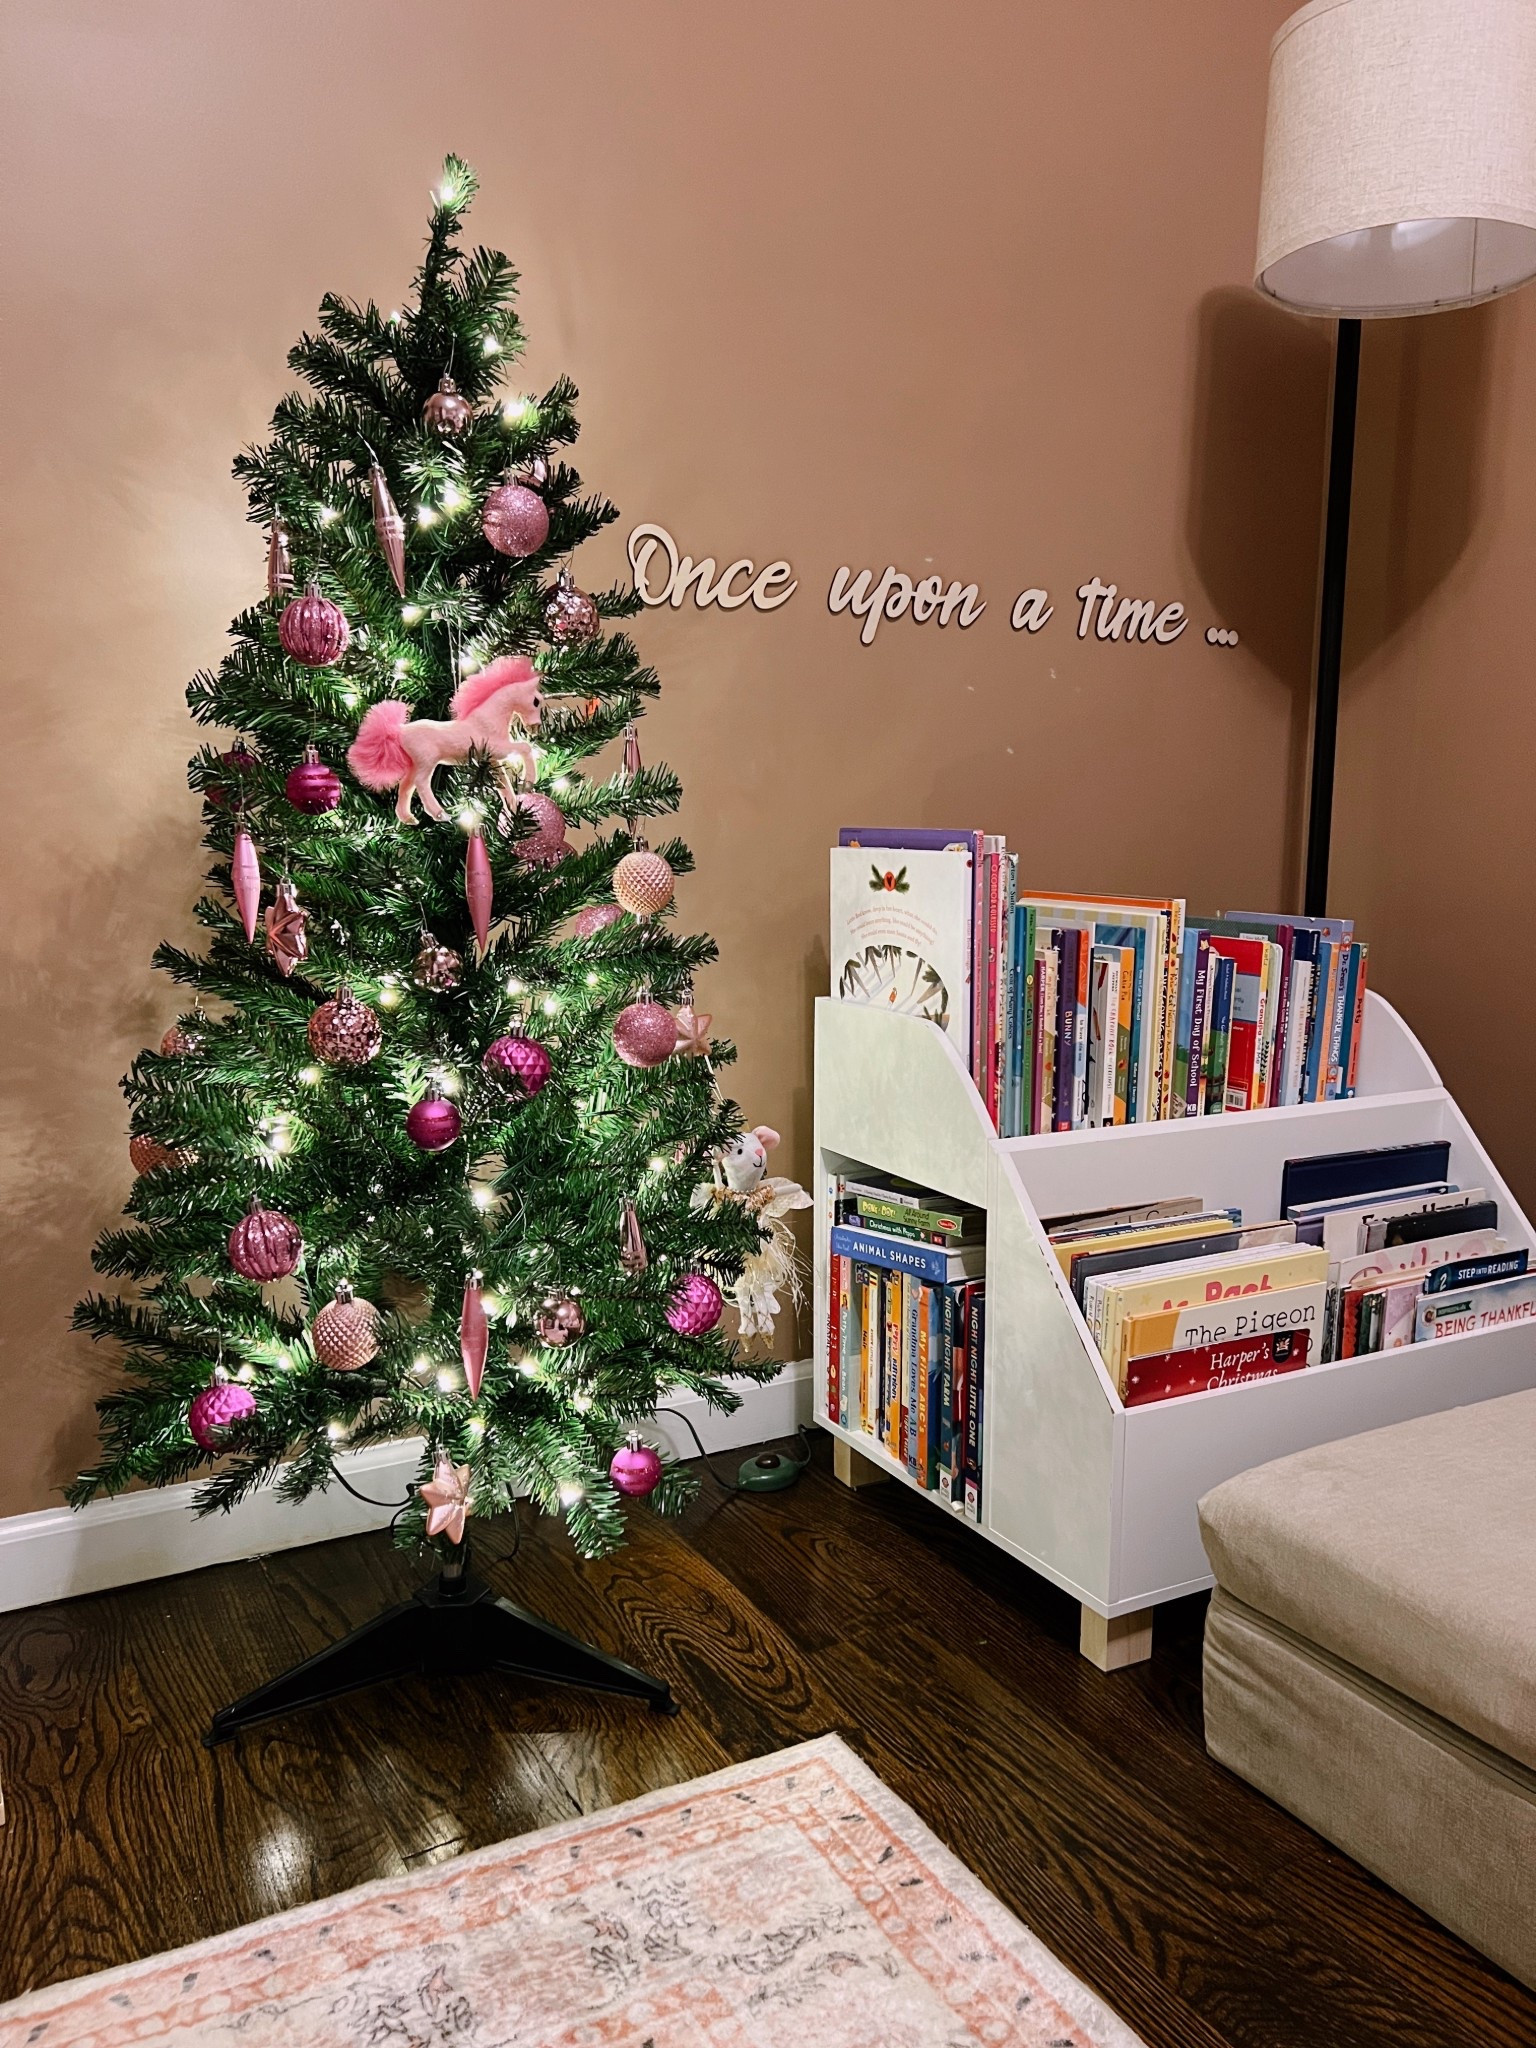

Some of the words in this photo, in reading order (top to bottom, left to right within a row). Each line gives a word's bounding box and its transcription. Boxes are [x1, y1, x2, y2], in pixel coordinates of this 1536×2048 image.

[627, 523, 798, 610] Once
[828, 565, 986, 646] upon
[1010, 584, 1055, 632] a
[1077, 576, 1189, 644] time
[1341, 954, 1350, 965] Dr.
[1196, 970, 1206, 985] My
[1194, 988, 1205, 1015] First
[1333, 994, 1345, 1034] THANKFUL
[1064, 1011, 1073, 1047] BUNNY
[1192, 1018, 1203, 1036] Day
[1257, 998, 1266, 1035] Grandpa
[1192, 1040, 1202, 1051] of
[1255, 1052, 1261, 1065] Me
[1330, 1036, 1341, 1063] THINGS
[1189, 1053, 1201, 1087] School
[869, 1219, 891, 1232] Christmas
[892, 1227, 902, 1235] with
[903, 1215, 917, 1227] Sunny
[904, 1207, 912, 1216] All
[912, 1209, 929, 1220] Around
[852, 1242, 886, 1259] ANIMAL
[890, 1251, 926, 1269] SHAPES
[1438, 1273, 1448, 1292] 2
[1457, 1268, 1475, 1280] STEP
[1476, 1268, 1488, 1276] INTO
[1487, 1260, 1519, 1275] READING
[944, 1296, 952, 1333] NIGHT
[970, 1306, 979, 1344] NIGHT
[1185, 1325, 1227, 1346] The
[1234, 1305, 1316, 1338] Pigeon
[1435, 1315, 1477, 1339] BEING
[943, 1334, 951, 1372] NIGHT
[969, 1345, 978, 1385] NIGHT
[1210, 1342, 1270, 1371] Harper's
[1206, 1368, 1279, 1391] Christmas
[910, 1397, 917, 1414] Me
[919, 1393, 927, 1434] ABC's
[968, 1384, 978, 1419] LITTLE
[968, 1421, 976, 1448] ONE
